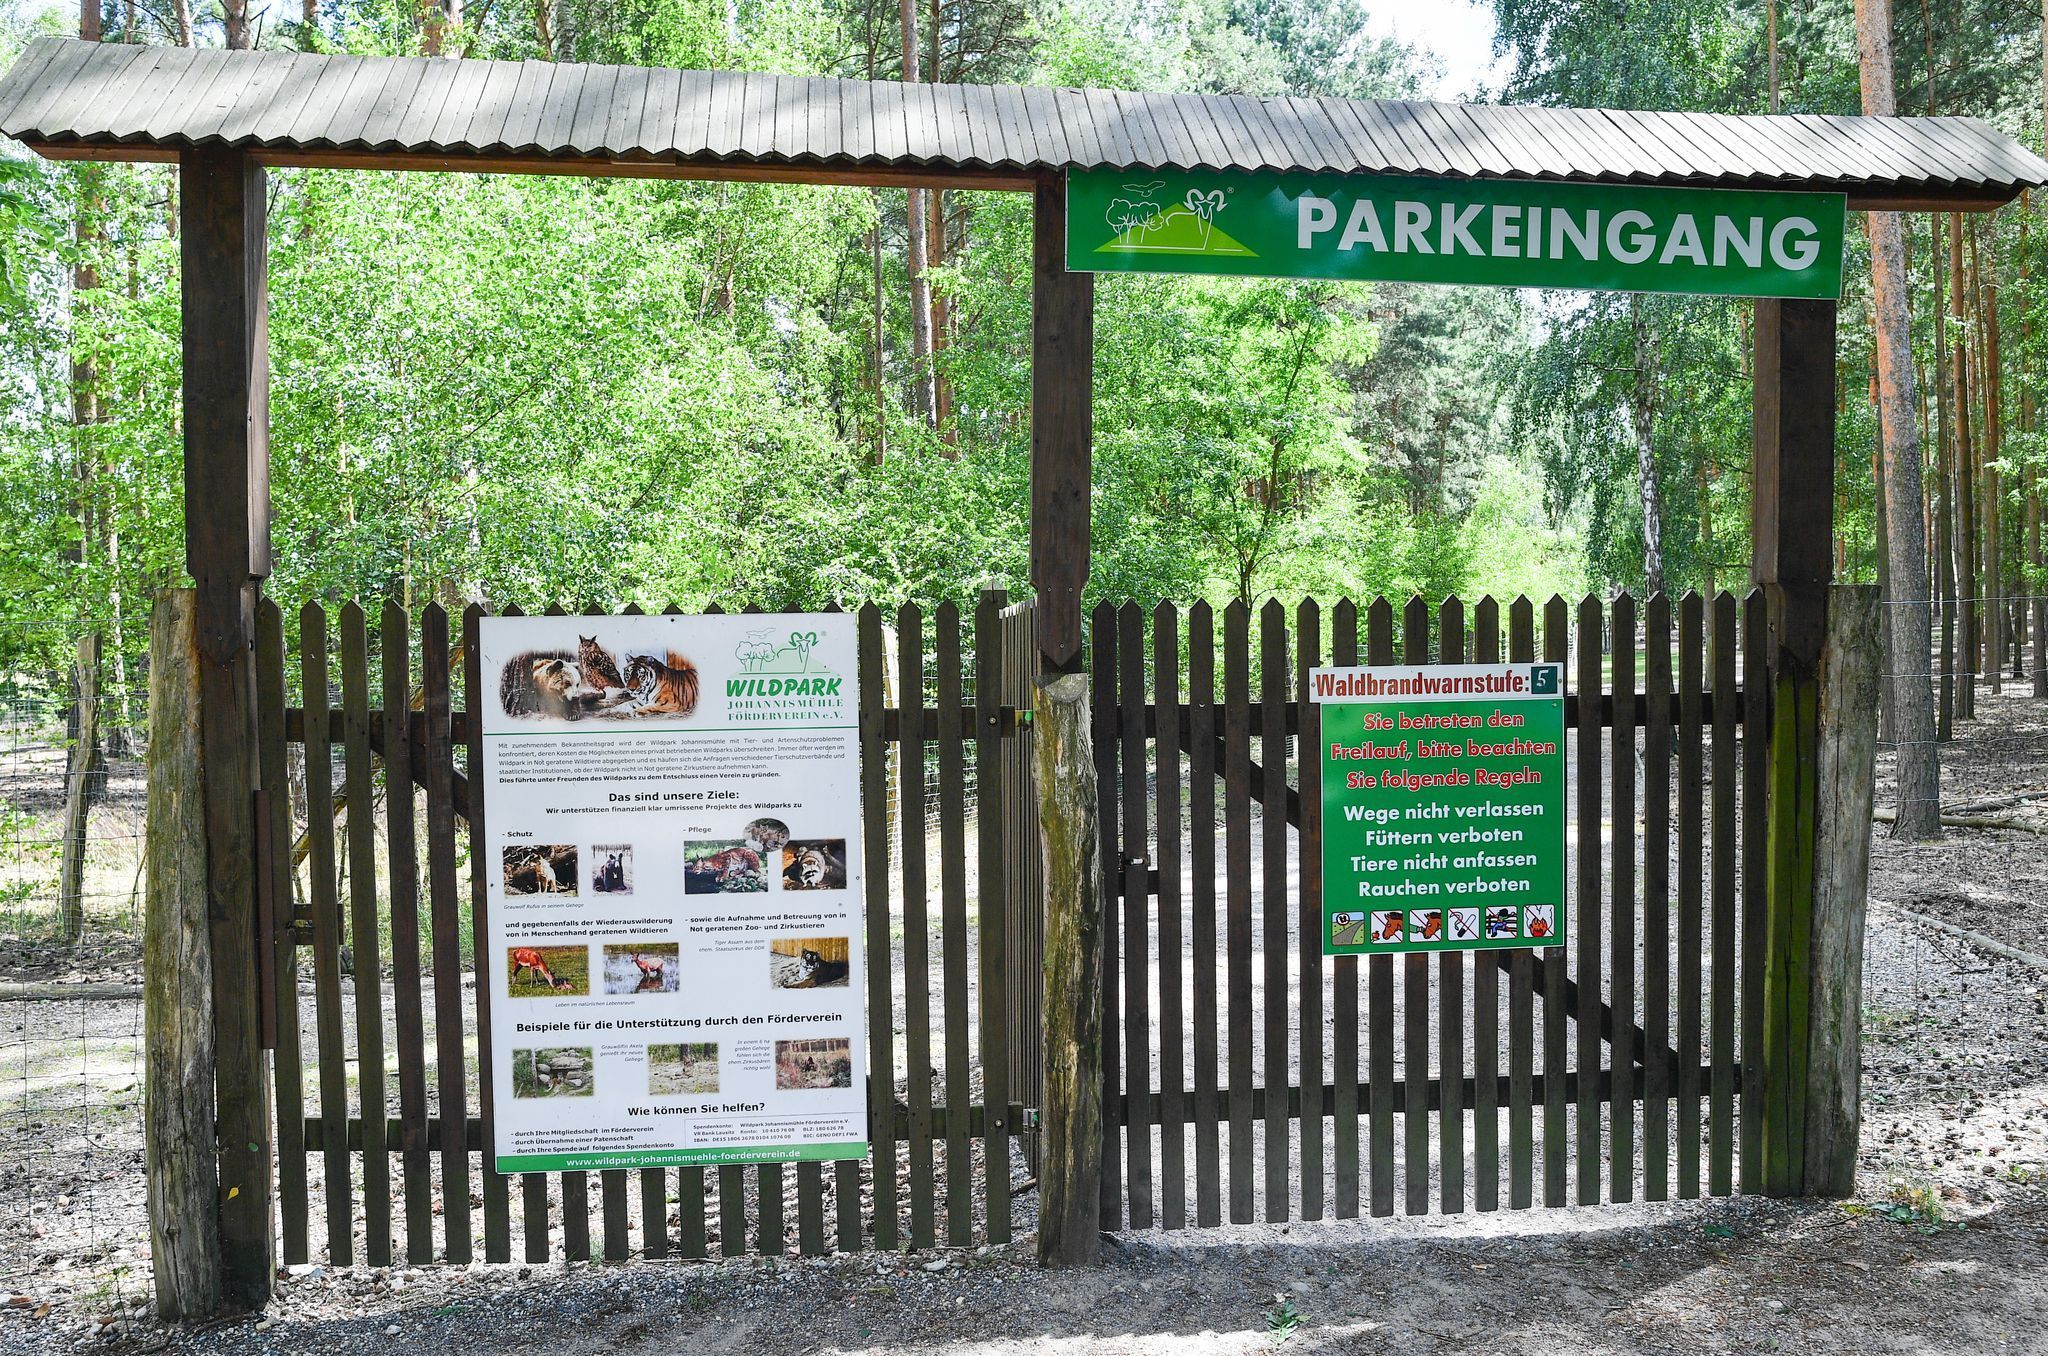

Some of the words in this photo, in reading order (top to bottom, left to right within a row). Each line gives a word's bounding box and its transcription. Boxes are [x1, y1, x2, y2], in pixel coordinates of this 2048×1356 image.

[1297, 197, 1821, 271] PARKEINGANG
[726, 678, 843, 697] WILDPARK
[1316, 670, 1530, 696] Waldbrandwarnstufe:
[1536, 670, 1548, 687] 5
[727, 697, 844, 710] JOHANNISMÜHLE
[728, 711, 820, 721] FÖRDERVEREIN
[1364, 713, 1394, 730] Sie
[1399, 711, 1482, 730] betreten
[1488, 710, 1524, 727] den
[1331, 740, 1412, 760] Freilauf,
[1418, 740, 1462, 758] bitte
[1467, 738, 1556, 757] beachten
[603, 774, 637, 783] Wildparks
[751, 771, 781, 779] gründen.
[1346, 772, 1376, 788] Sie
[1382, 769, 1470, 791] folgende
[1475, 766, 1541, 788] Regeln
[609, 793, 631, 802] Das
[634, 792, 659, 801] sind
[663, 793, 704, 801] unsere
[707, 790, 740, 800] Ziele:
[561, 806, 610, 814] unterstützen
[705, 803, 737, 812] Projekte
[754, 802, 791, 810] Wildparks
[1344, 806, 1400, 824] Wege
[1406, 804, 1450, 819] nicht
[1455, 800, 1544, 818] verlassen
[507, 830, 533, 838] Schutz
[688, 826, 712, 834] Pflege
[1366, 830, 1432, 846] Füttern
[1438, 827, 1522, 844] verboten
[1351, 856, 1398, 872] Tiere
[1404, 854, 1448, 870] nicht
[1453, 852, 1536, 868] anfassen
[1359, 880, 1439, 896] Rauchen
[1445, 878, 1530, 894] verboten
[522, 920, 579, 929] gegebenenfalls
[596, 918, 673, 927] Wiederauswilderung
[727, 914, 765, 922] Aufnahme
[783, 913, 822, 922] Betreuung
[531, 929, 587, 937] Menschenhand
[589, 928, 627, 937] geratenen
[705, 924, 743, 933] geratenen
[780, 922, 825, 930] Zirkustieren
[516, 1021, 570, 1034] Beispiele
[574, 1021, 591, 1030] für
[595, 1020, 613, 1029] die
[617, 1017, 701, 1031] Unterstützung
[704, 1016, 739, 1026] durch
[741, 1015, 764, 1025] den
[767, 1013, 842, 1024] Förderverein
[628, 1107, 650, 1116] Wie
[654, 1105, 697, 1115] können
[700, 1104, 719, 1113] Sie
[722, 1103, 765, 1113] helfen?
[551, 1128, 598, 1137] Mitgliedschaft
[535, 1136, 575, 1145] Übernahme
[553, 1145, 578, 1154] Spende
[592, 1143, 625, 1152] folgendes
[626, 1141, 675, 1151] Spendenkonto
[566, 1150, 801, 1166] www.wildpark-johannismuehle-foerderverein.de
